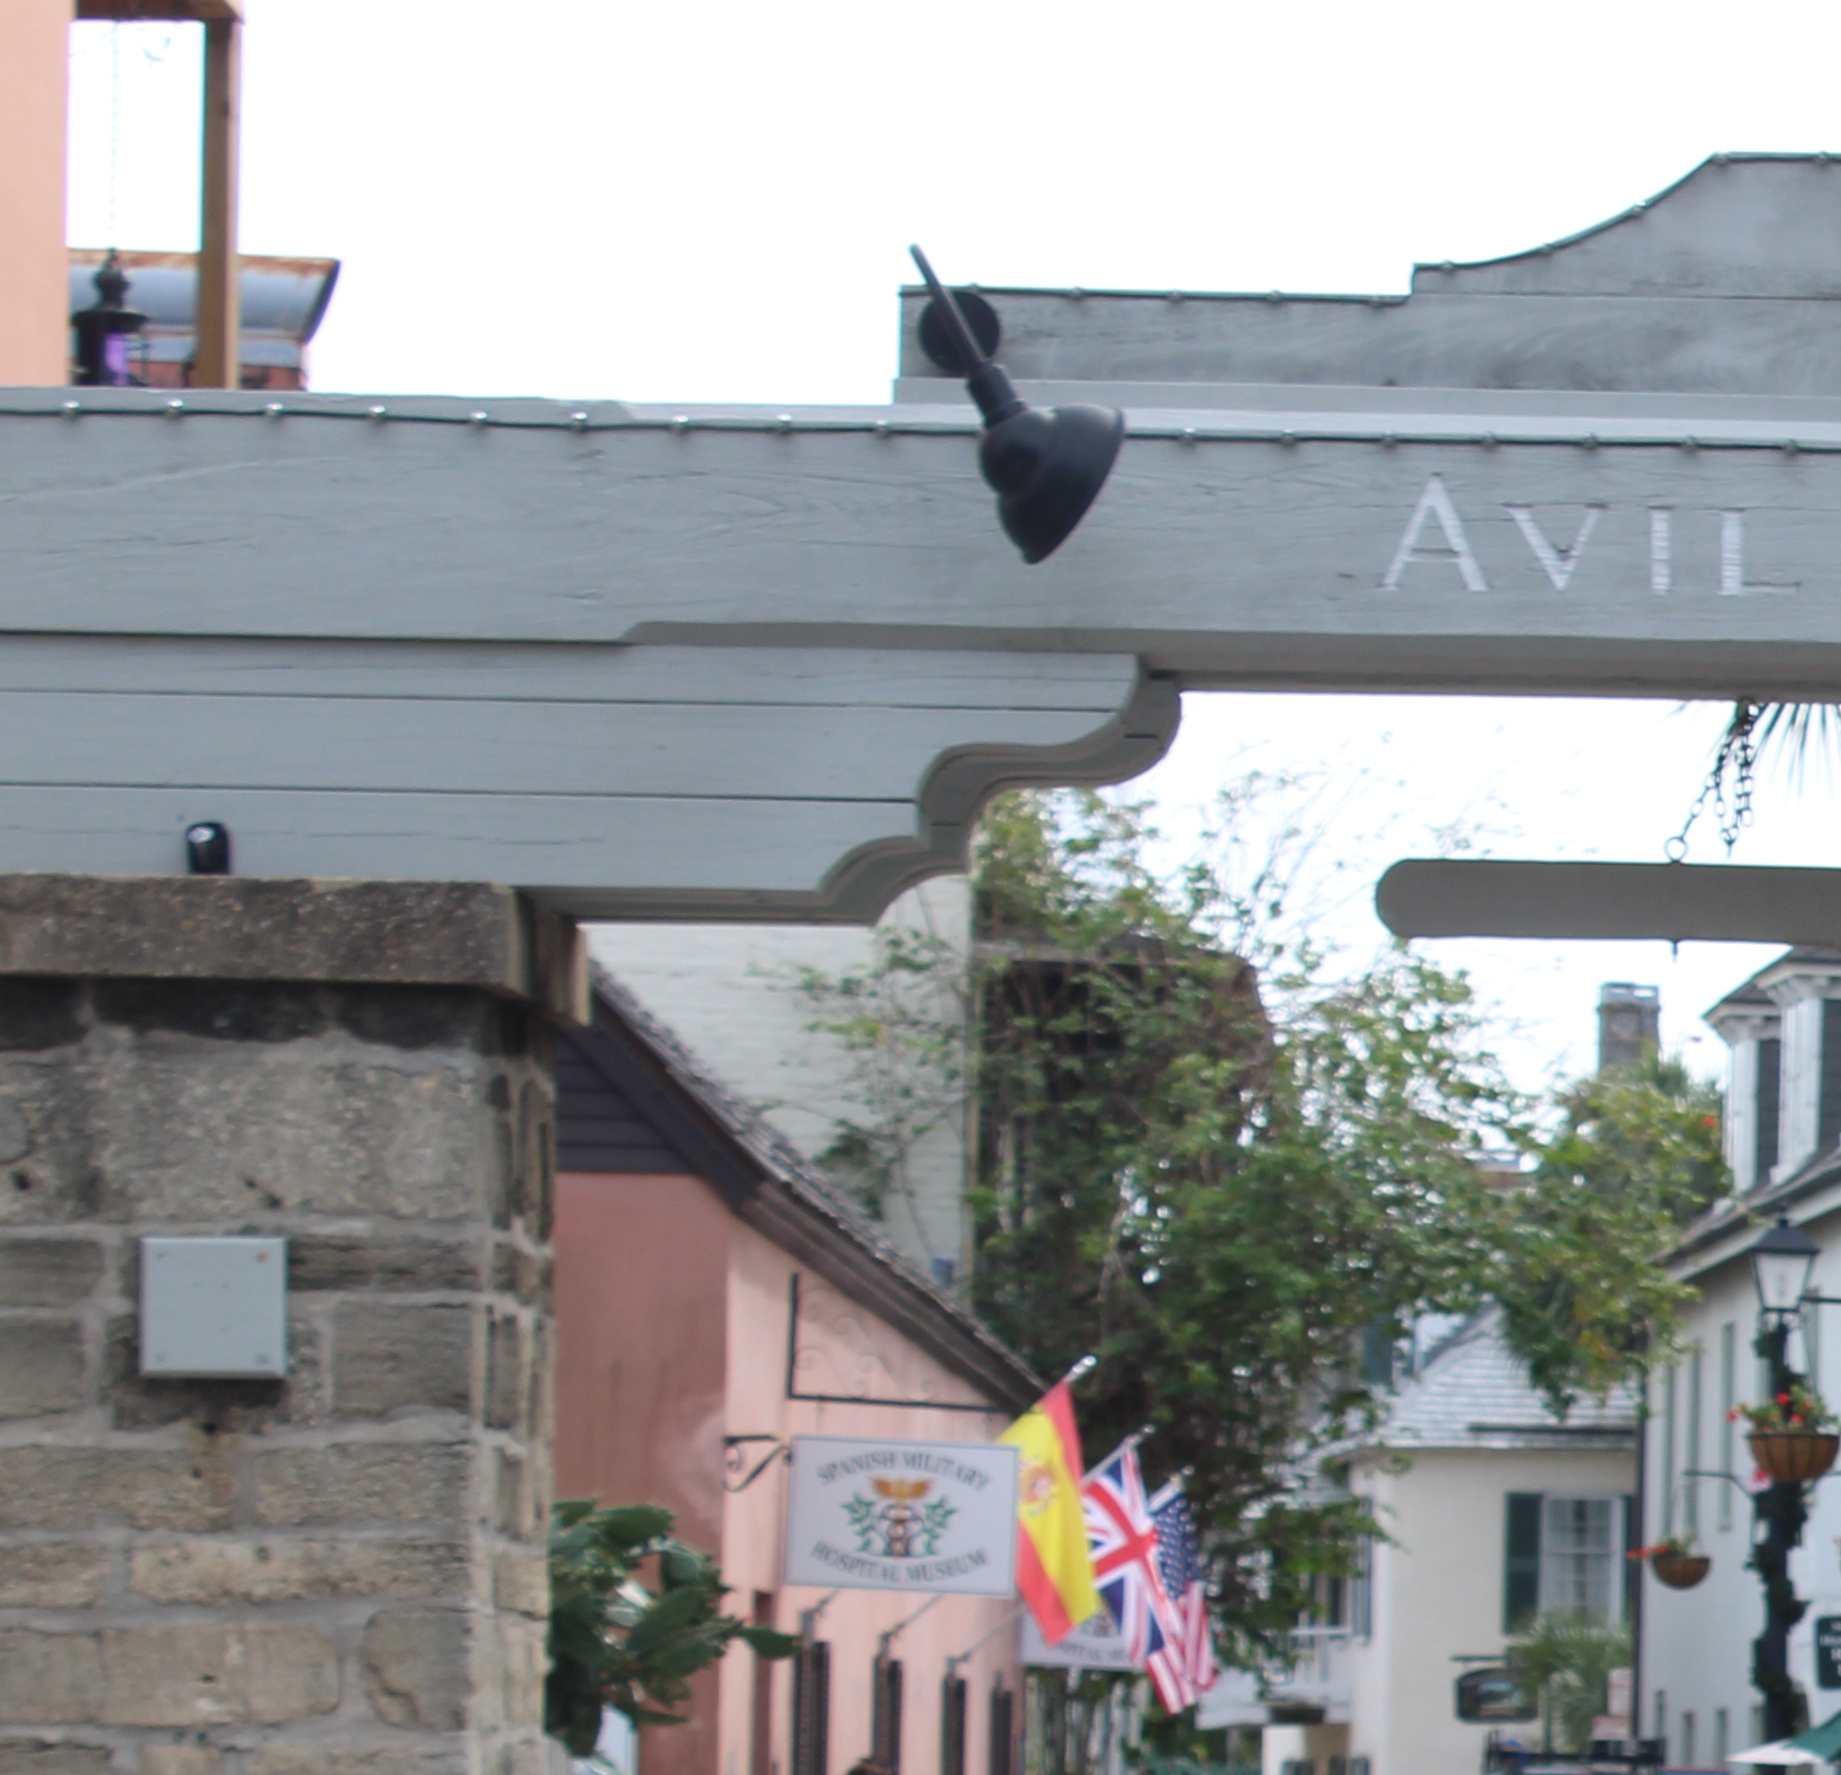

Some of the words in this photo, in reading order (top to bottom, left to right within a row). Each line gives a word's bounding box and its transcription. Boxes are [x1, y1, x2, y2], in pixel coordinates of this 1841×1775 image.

[816, 1450, 897, 1485] SPANISH
[902, 1452, 990, 1492] MILITARY
[810, 1540, 900, 1582] HOSPITAL
[906, 1550, 989, 1582] MUSEUM
